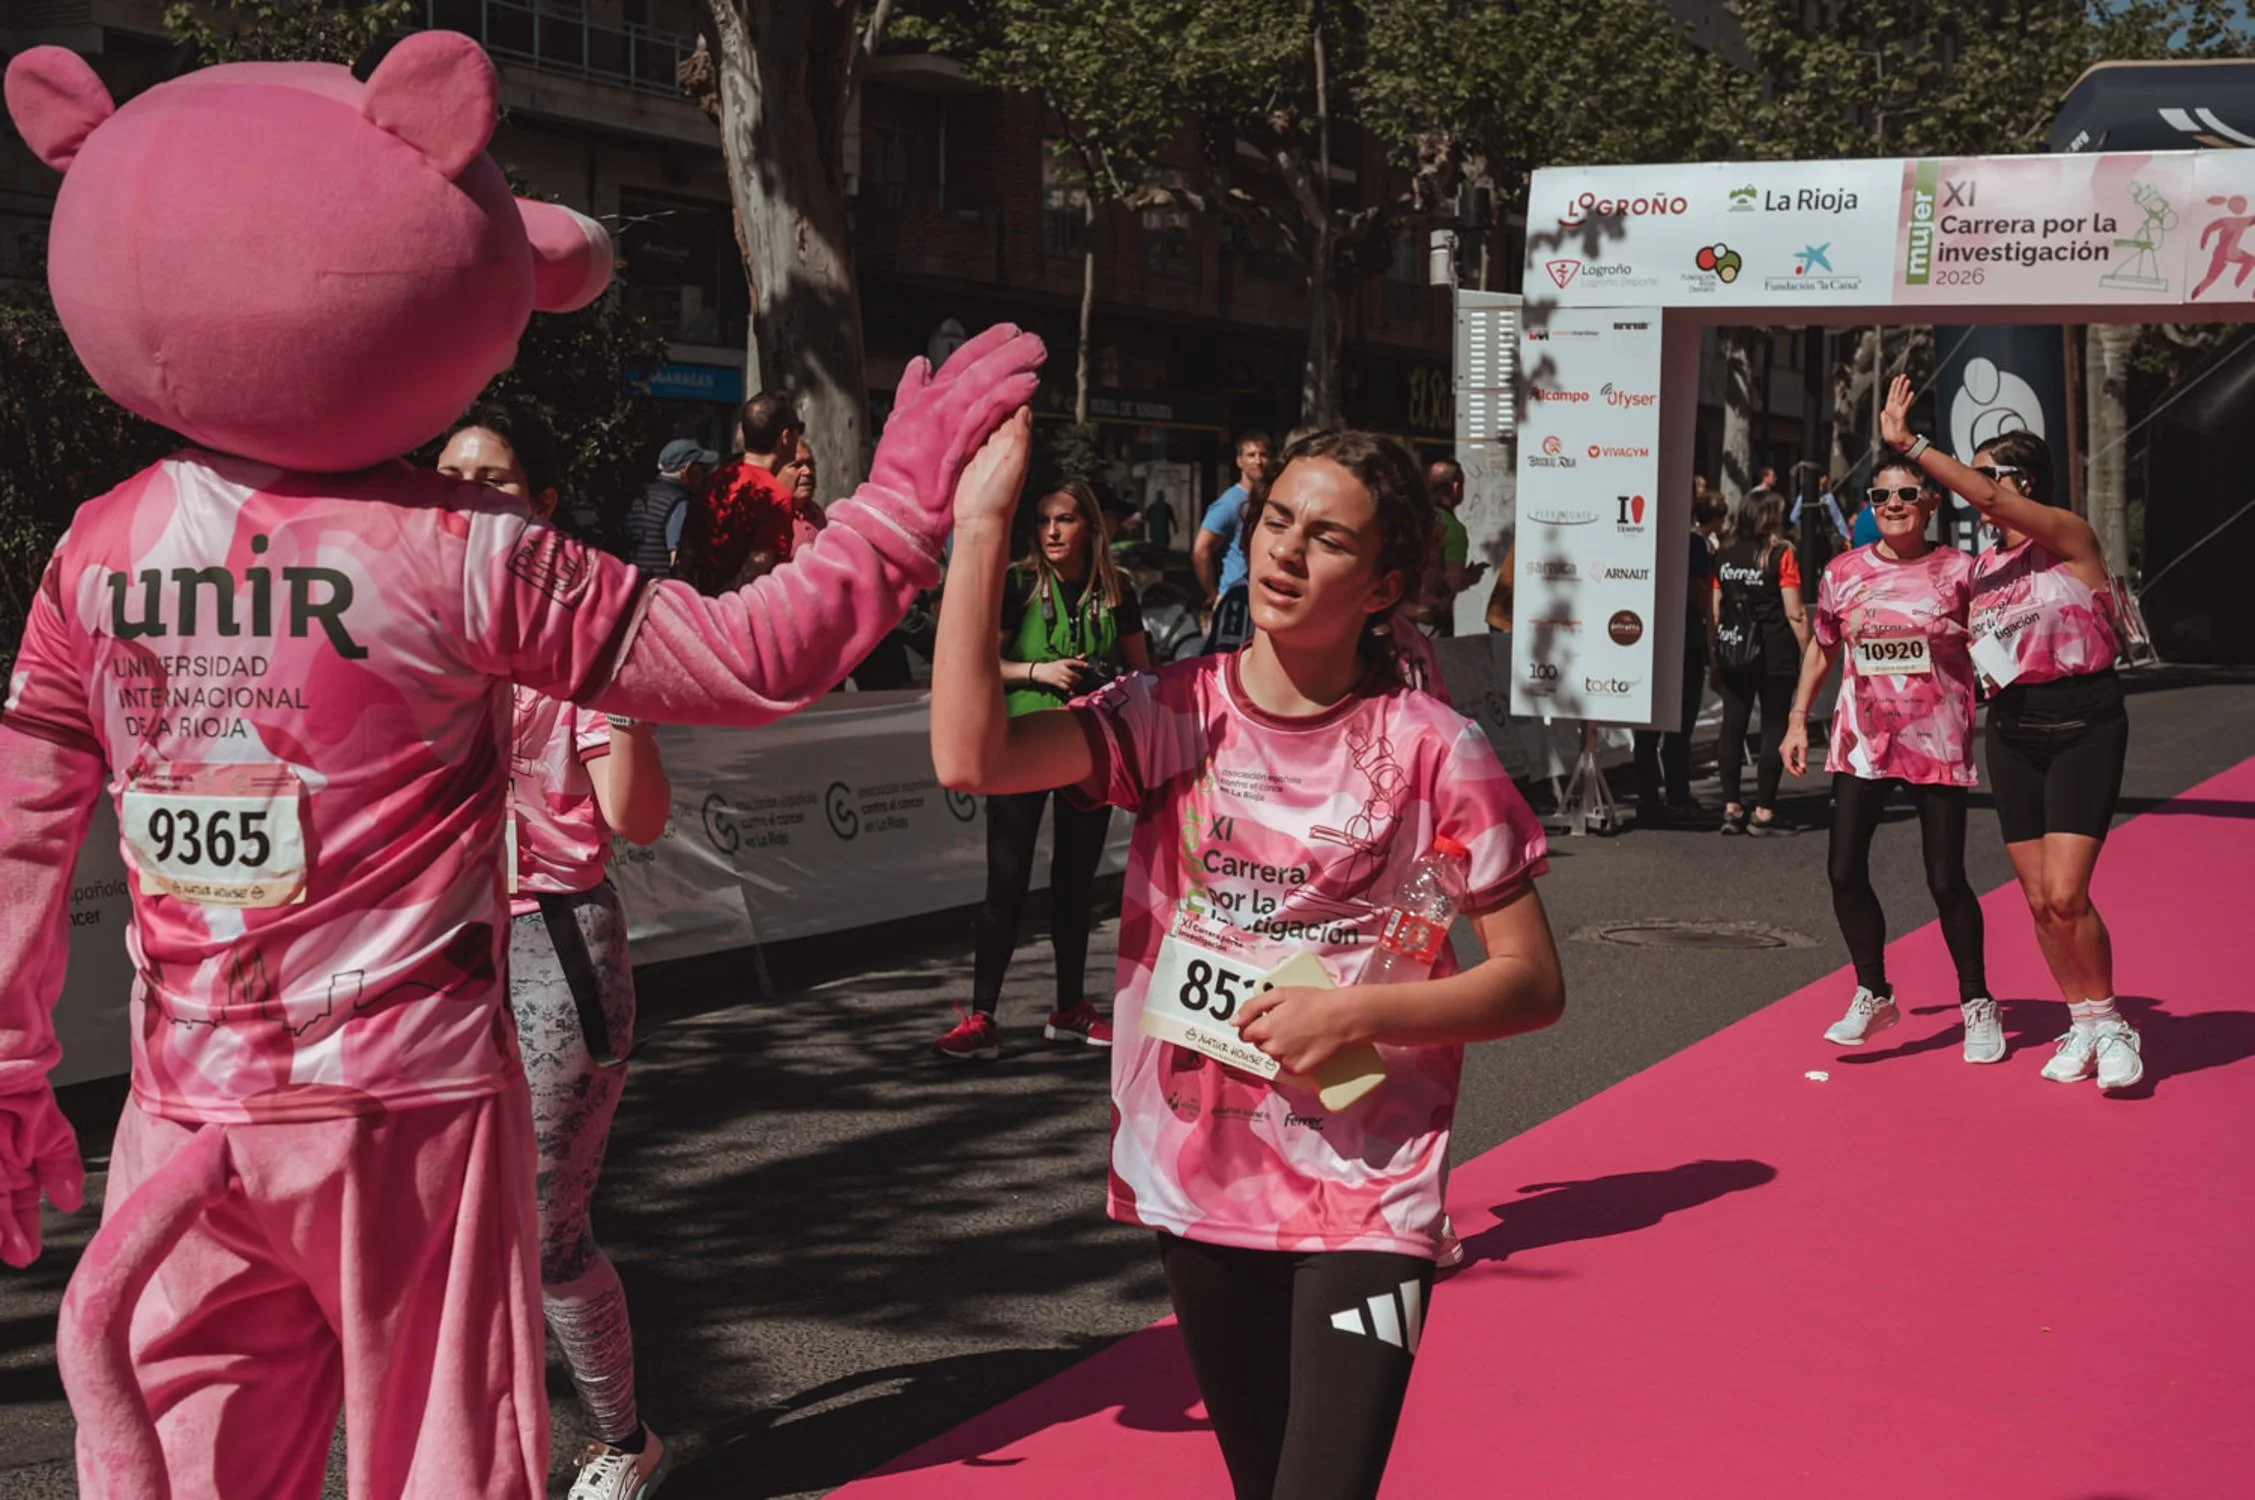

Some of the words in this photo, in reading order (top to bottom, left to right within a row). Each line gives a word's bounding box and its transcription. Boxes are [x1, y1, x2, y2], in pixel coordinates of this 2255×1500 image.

[1568, 192, 1688, 217] LOGROÑO
[1765, 189, 1791, 211] La
[1797, 188, 1858, 214] Rioja
[1943, 180, 1977, 208] XI
[1908, 190, 1935, 276] mujer
[1940, 215, 2035, 235] Carrera
[2042, 217, 2087, 239] por
[2094, 213, 2117, 234] la
[1938, 241, 2110, 267] investigación
[1582, 263, 1632, 278] Logroño
[1936, 268, 1985, 286] 2026
[1765, 281, 1815, 291] Fundación
[1530, 387, 1590, 404] Alcampo
[1602, 447, 1649, 458] VIVAGYM
[1604, 568, 1650, 580] ARNAUT
[1860, 641, 1924, 661] 10920
[113, 656, 268, 678] UNIVERSIDAD
[1529, 663, 1558, 680] 100
[179, 716, 248, 739] RIOJA
[148, 807, 270, 867] 9365
[1207, 814, 1234, 842] XI
[1203, 848, 1308, 886] Carrera
[70, 878, 128, 906] pañola
[1252, 889, 1277, 915] la
[1181, 916, 1193, 929] XI
[1179, 958, 1256, 1021] 85
